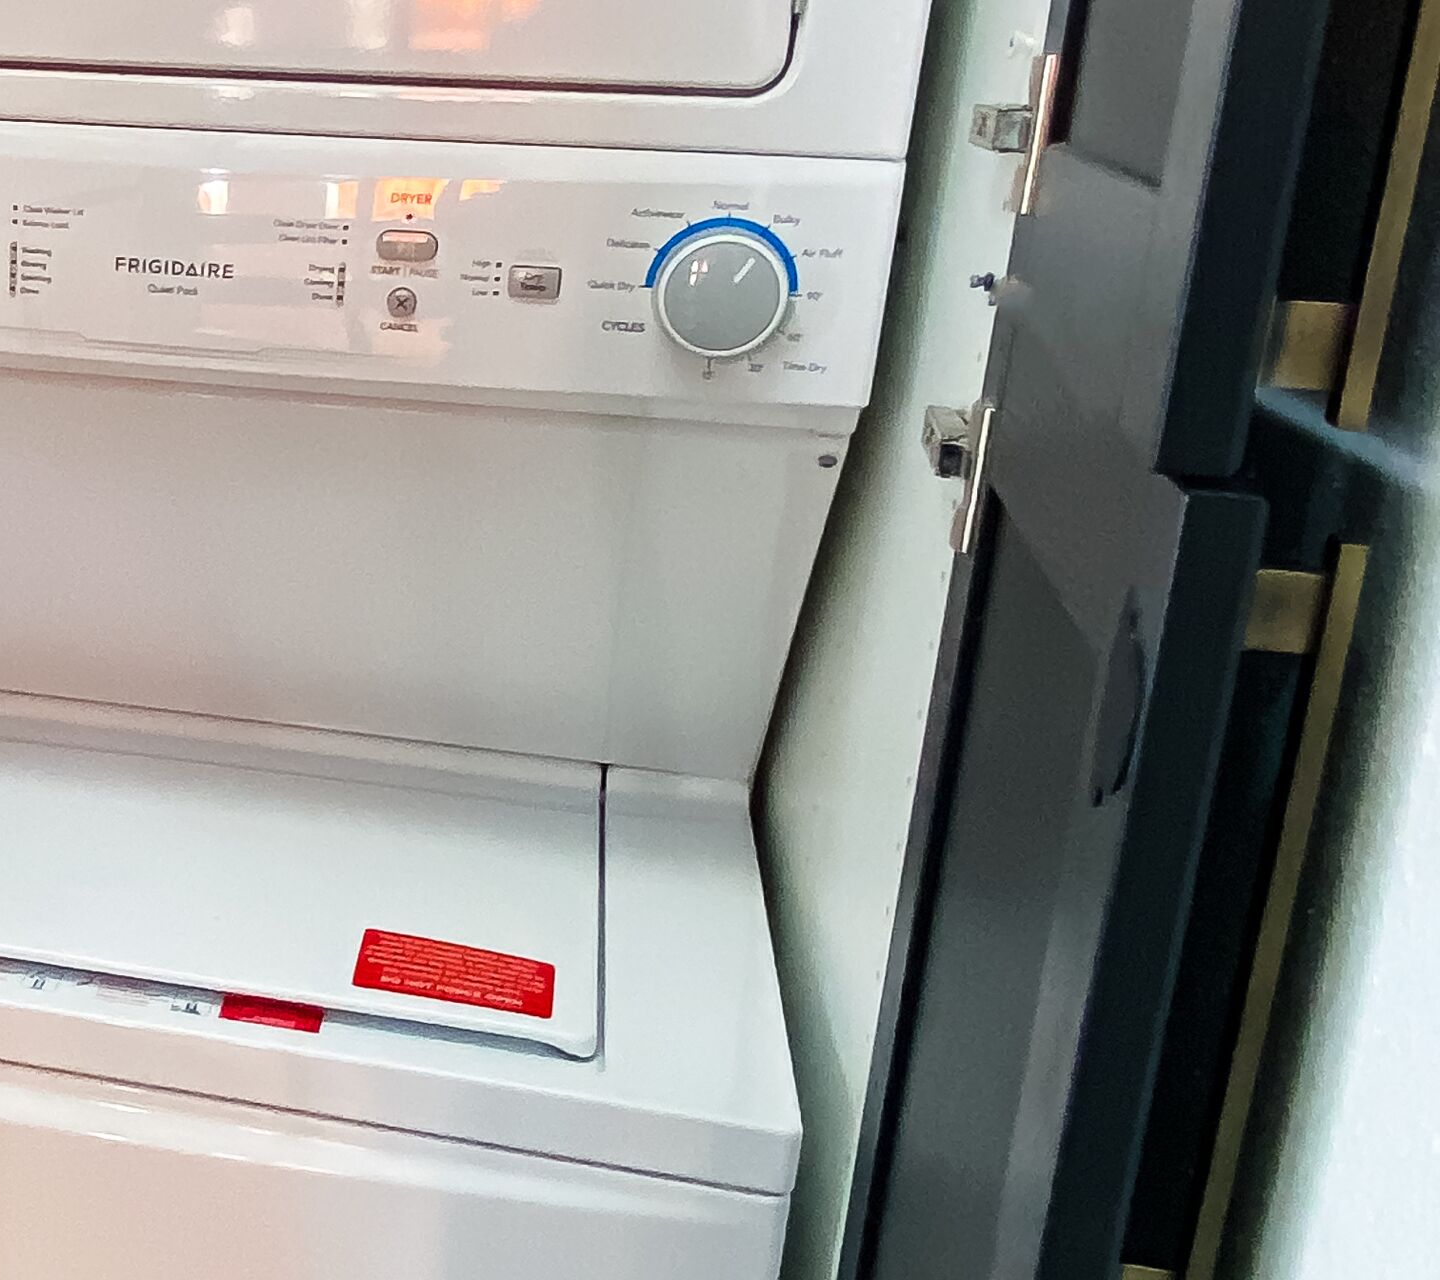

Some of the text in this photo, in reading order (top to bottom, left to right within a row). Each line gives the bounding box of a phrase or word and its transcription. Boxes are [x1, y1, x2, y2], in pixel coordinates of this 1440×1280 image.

[390, 192, 433, 205] DRYER
[115, 257, 234, 279] FRIGIDAIRE
[369, 265, 401, 275] START
[601, 320, 646, 333] CYCLES
